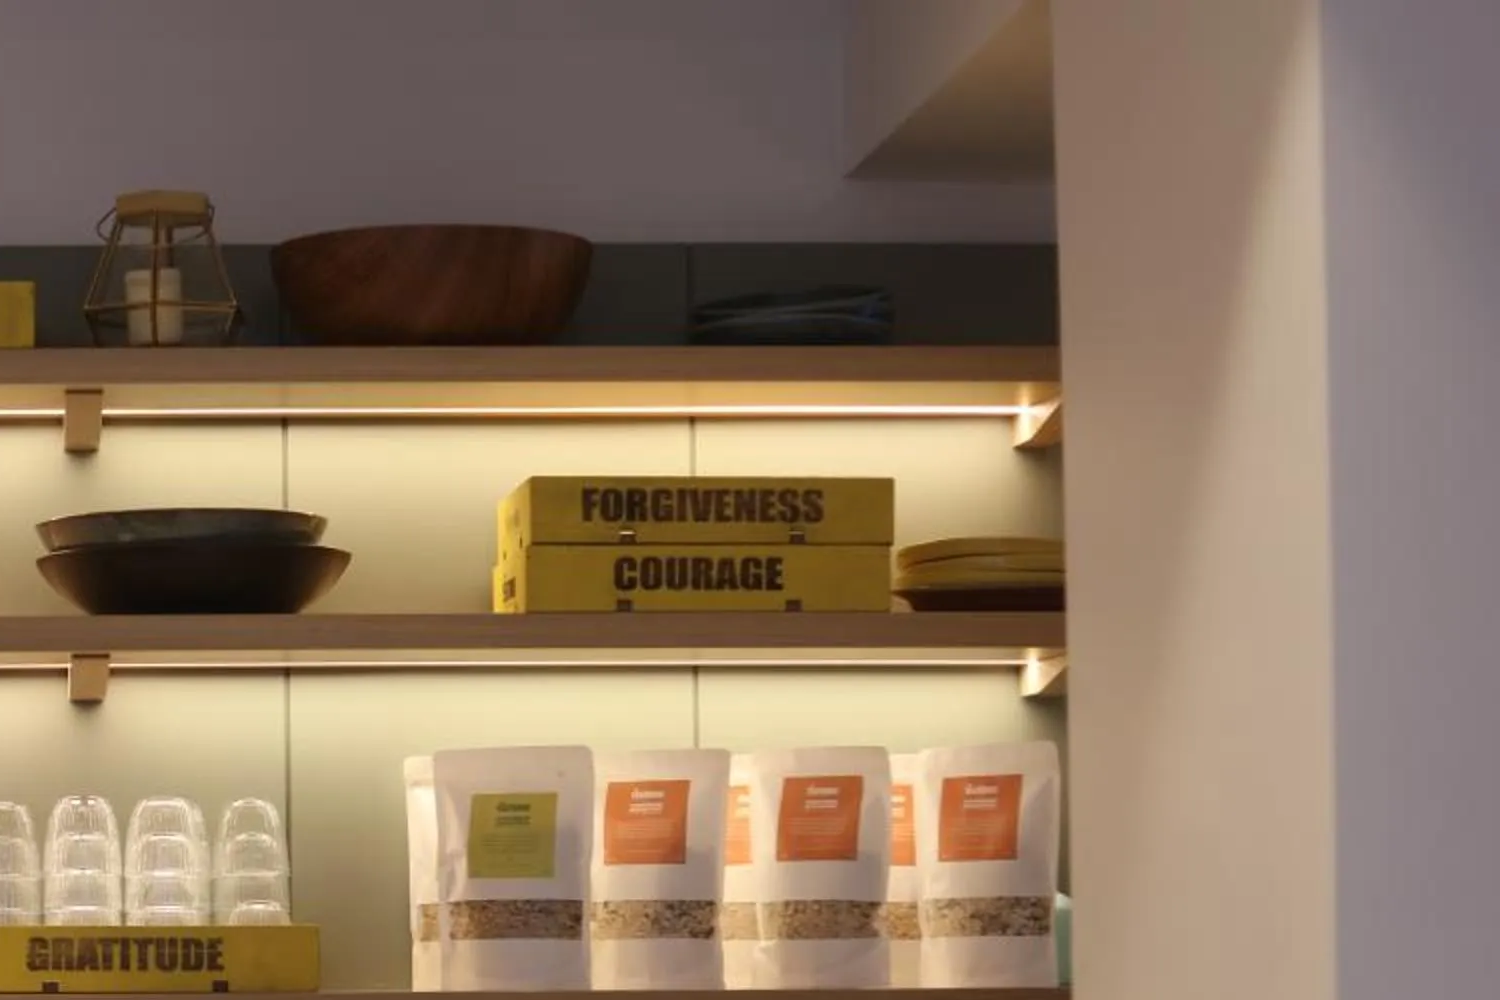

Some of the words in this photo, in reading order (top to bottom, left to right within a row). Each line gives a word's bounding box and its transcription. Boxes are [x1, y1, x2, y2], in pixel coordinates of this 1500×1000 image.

[580, 487, 825, 524] FORGIVENESS
[613, 556, 785, 592] COURAGE
[26, 936, 226, 972] GRATITUDE
